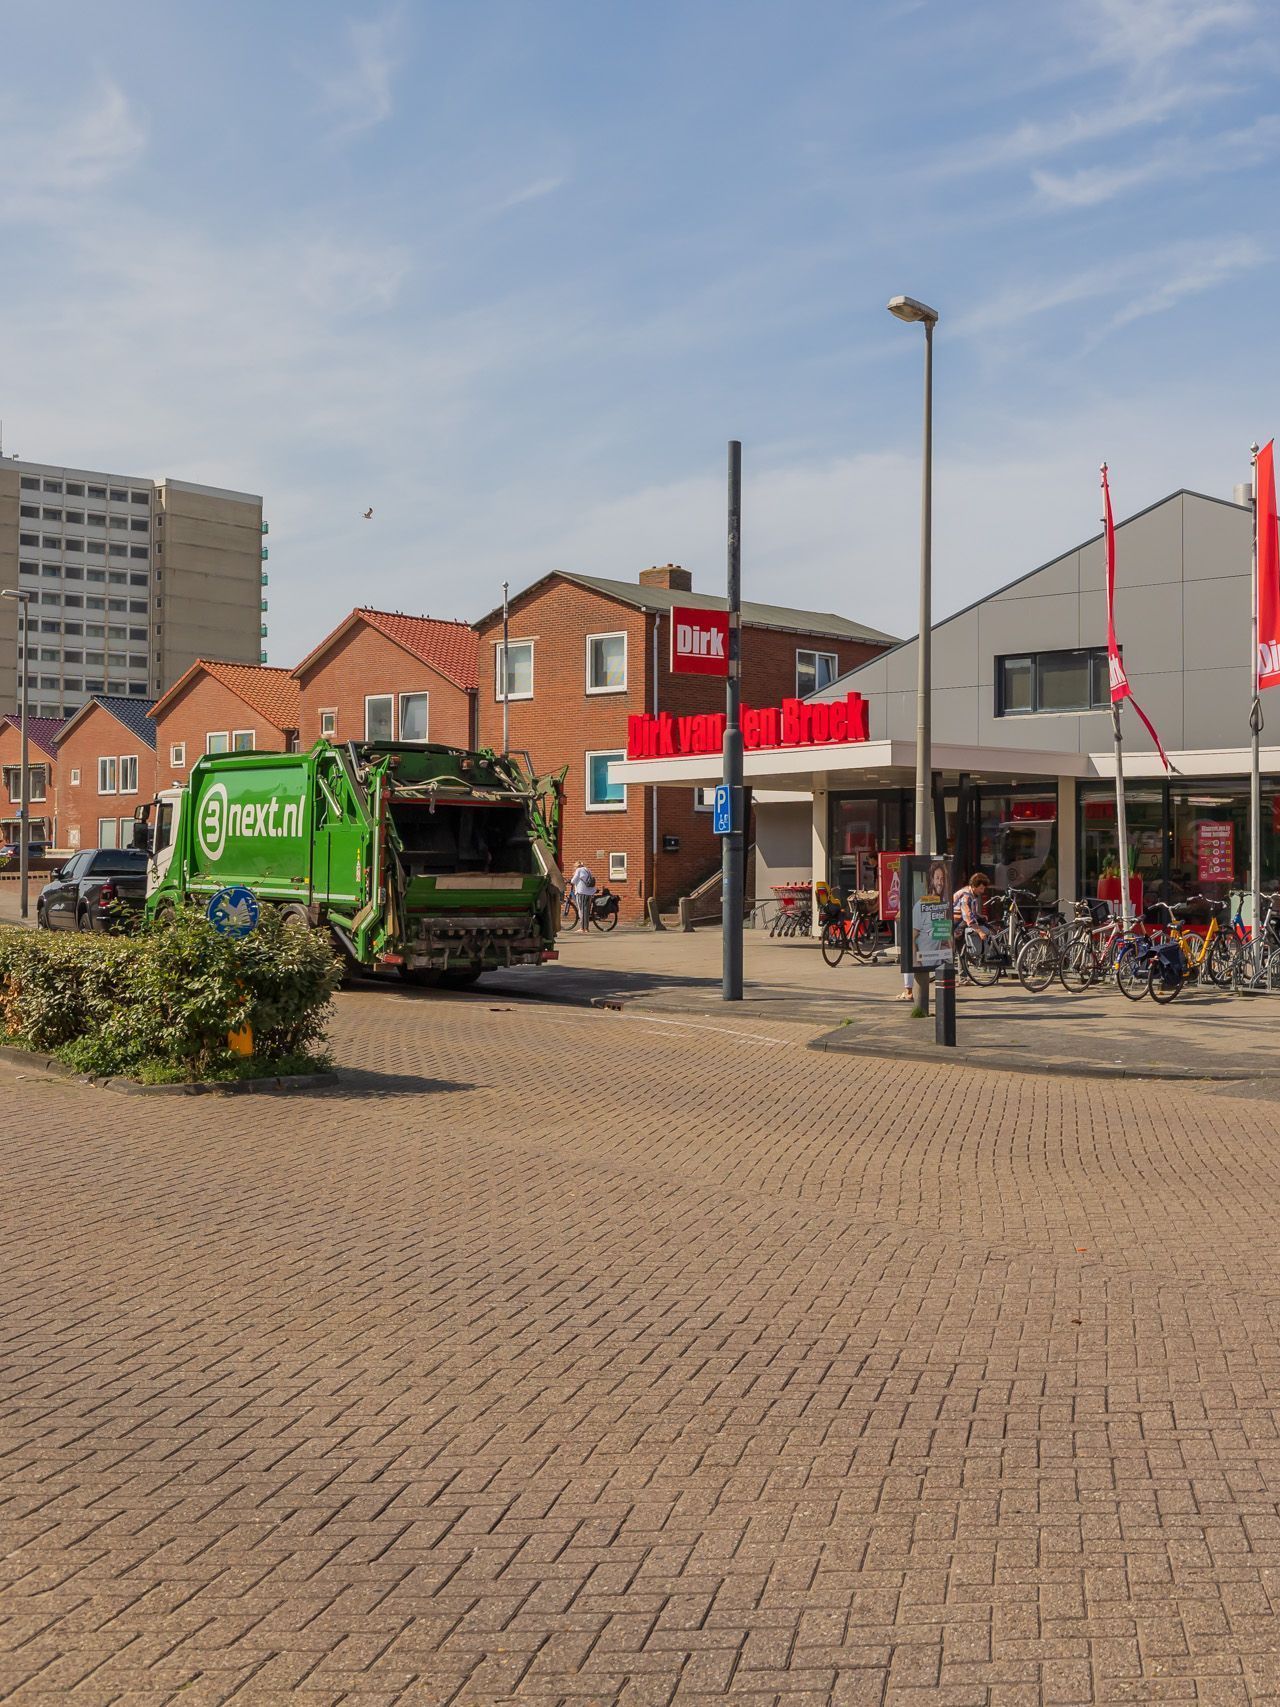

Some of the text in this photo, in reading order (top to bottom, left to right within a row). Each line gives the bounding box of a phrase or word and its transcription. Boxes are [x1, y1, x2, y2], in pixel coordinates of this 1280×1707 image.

[677, 624, 724, 656] Dirk
[627, 712, 678, 757] Dirk
[678, 713, 726, 753] van
[782, 692, 869, 744] Broek
[718, 790, 726, 813] P
